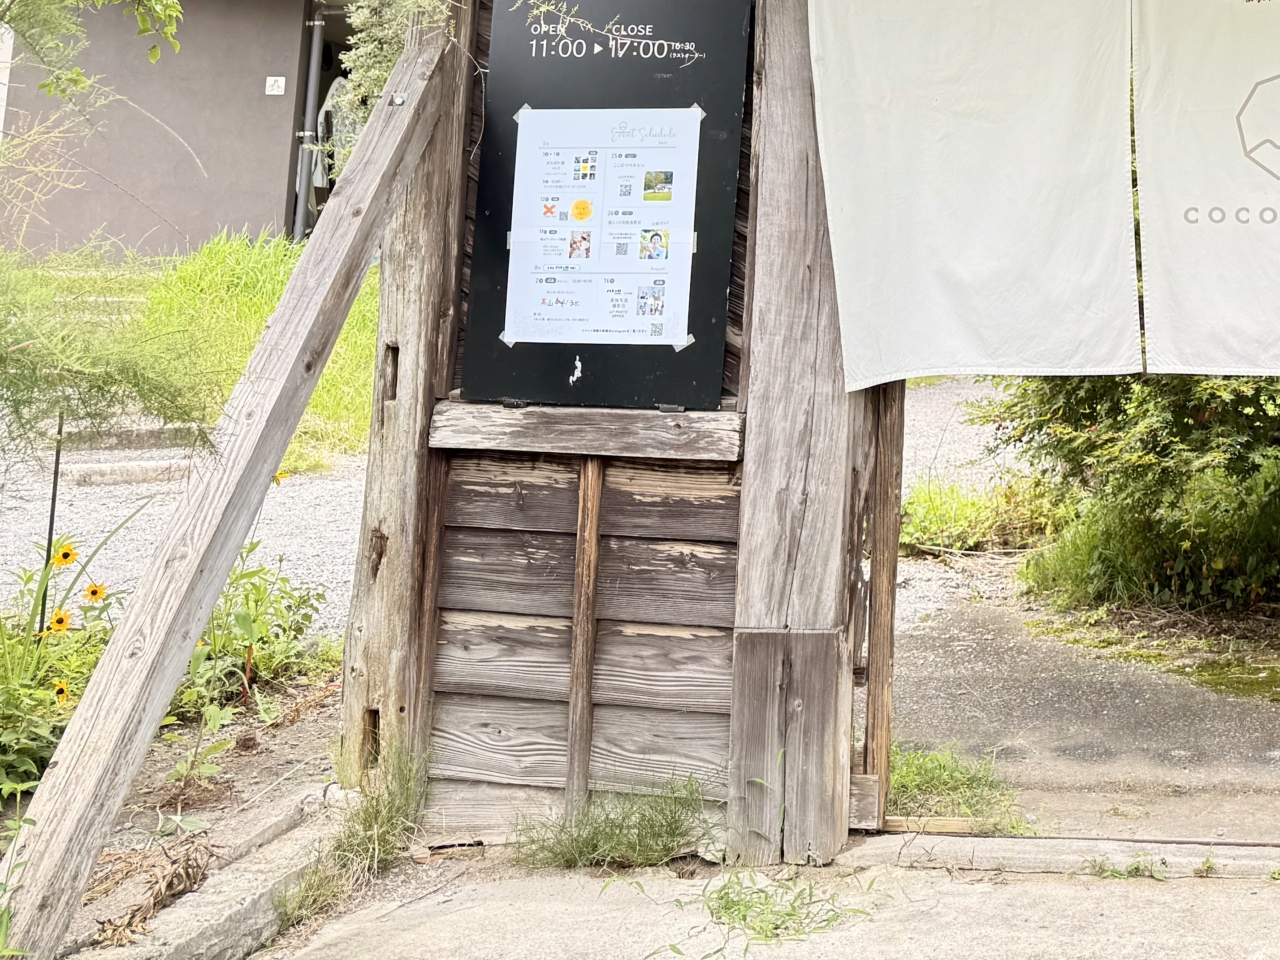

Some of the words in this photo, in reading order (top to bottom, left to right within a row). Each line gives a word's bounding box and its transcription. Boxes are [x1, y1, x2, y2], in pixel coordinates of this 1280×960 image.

[530, 24, 566, 35] OPEN
[612, 24, 654, 36] CLOSE
[529, 38, 587, 58] 11:00
[611, 39, 668, 58] 17:00
[671, 42, 696, 50] 16:30
